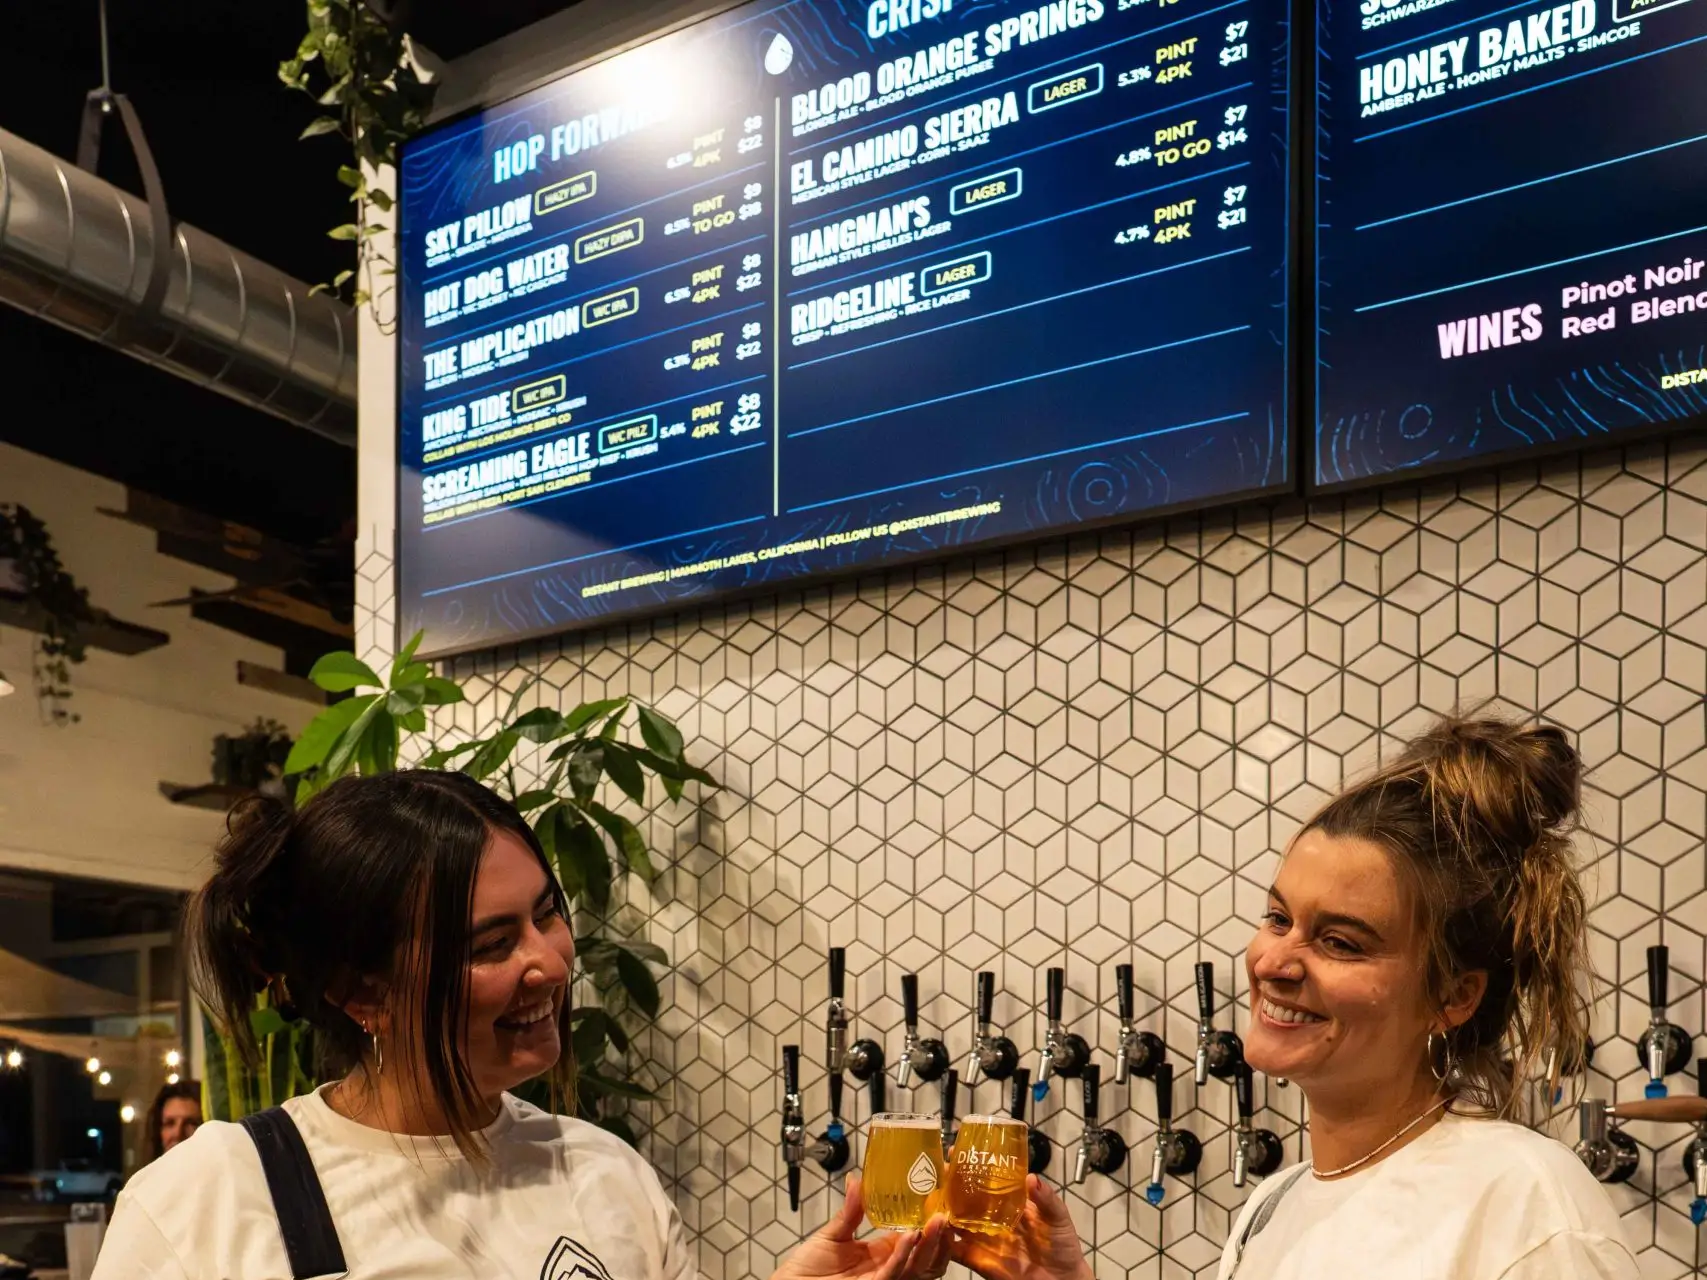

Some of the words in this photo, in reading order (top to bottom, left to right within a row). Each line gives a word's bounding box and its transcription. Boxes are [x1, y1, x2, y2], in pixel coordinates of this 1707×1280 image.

[1155, 37, 1198, 64] PINT
[1225, 20, 1249, 42] $7
[1360, 36, 1469, 104] HONEY
[1479, 0, 1596, 68] BAKED
[791, 71, 871, 126] BLOOD
[876, 31, 980, 95] ORANGE
[984, 0, 1105, 57] SPRINGS
[1117, 65, 1152, 87] 5.3%
[1155, 61, 1193, 84] 4PK
[1219, 43, 1248, 67] $21
[1361, 92, 1415, 118] AMBER
[1416, 82, 1446, 102] ALE
[1456, 61, 1512, 89] HONEY
[1513, 45, 1566, 72] MALTS
[1576, 22, 1641, 52] SIMCOE
[838, 105, 859, 122] ALE
[865, 92, 905, 112] BLOOD
[906, 72, 954, 98] ORANGE
[1044, 77, 1087, 102] LAGER
[693, 128, 725, 151] PINT
[790, 159, 818, 194] EL
[822, 124, 919, 183] CAMINO
[924, 91, 1020, 150] SIERRA
[1154, 120, 1198, 145] PINT
[1224, 104, 1248, 126] $7
[493, 134, 545, 184] HOP
[692, 149, 721, 168] 4PK
[840, 169, 873, 190] STYLE
[958, 132, 991, 152] SAAZ
[1115, 146, 1152, 167] 4.8%
[1154, 147, 1180, 166] TO
[1182, 138, 1212, 159] GO
[1216, 127, 1248, 151] $14
[692, 195, 725, 216] PINT
[965, 181, 1006, 204] LAGER
[1153, 199, 1197, 224] PINT
[1223, 185, 1247, 206] $7
[425, 221, 461, 258] SKY
[464, 194, 532, 244] PILLOW
[692, 218, 712, 235] TO
[713, 210, 735, 228] GO
[791, 196, 931, 266] HANGMAN'S
[838, 245, 872, 263] STYLE
[913, 220, 952, 241] LAGER
[1114, 224, 1150, 244] 4.7%
[1153, 222, 1191, 244] 4PK
[1217, 207, 1247, 230] $21
[424, 281, 461, 319] HOT
[464, 266, 504, 305] DOG
[507, 243, 570, 290] WATER
[692, 264, 725, 287] PINT
[692, 284, 720, 303] 4PK
[736, 272, 762, 293] $22
[935, 264, 977, 286] LAGER
[1562, 274, 1637, 309] Pinot
[1644, 257, 1706, 290] Noir
[791, 272, 916, 335] RIDGELINE
[905, 299, 932, 316] RICE
[932, 289, 971, 309] LAGER
[1438, 302, 1543, 359] WINES
[1562, 306, 1616, 339] Red
[424, 346, 458, 380] THE
[461, 305, 580, 369] IMPLICATION
[691, 332, 725, 353] PINT
[691, 352, 720, 371] 4PK
[736, 340, 762, 360] $22
[422, 405, 467, 443] KING
[469, 391, 511, 427] TIDE
[691, 401, 724, 421] PINT
[738, 392, 761, 415] $8
[691, 421, 720, 439] 4PK
[729, 411, 761, 436] $22
[607, 427, 626, 445] WC
[422, 450, 527, 503] SCREAMING
[531, 432, 591, 474] EAGLE
[826, 526, 872, 547] FOLLOW
[872, 523, 889, 538] US
[957, 1150, 1018, 1171] DISTANT
